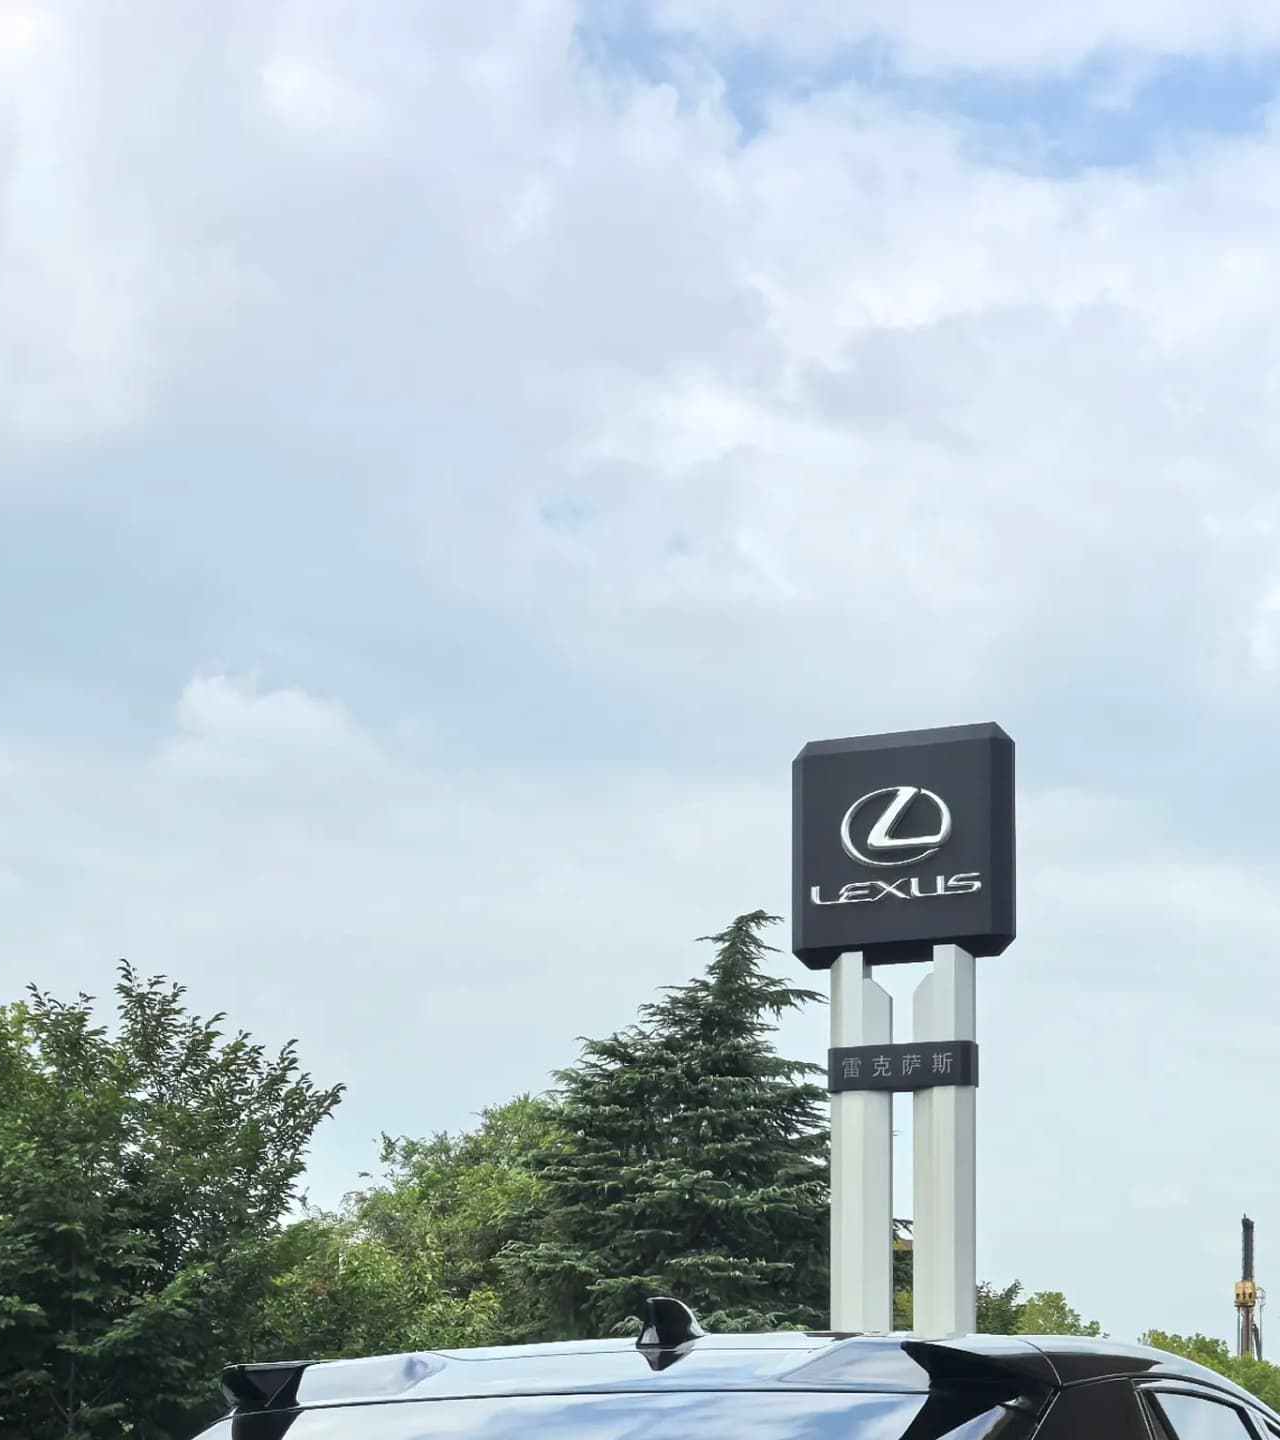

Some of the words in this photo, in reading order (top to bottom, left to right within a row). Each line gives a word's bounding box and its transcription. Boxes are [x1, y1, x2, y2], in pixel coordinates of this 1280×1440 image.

[811, 872, 981, 905] LEXUS
[841, 1051, 953, 1080] 雷克萨斯
